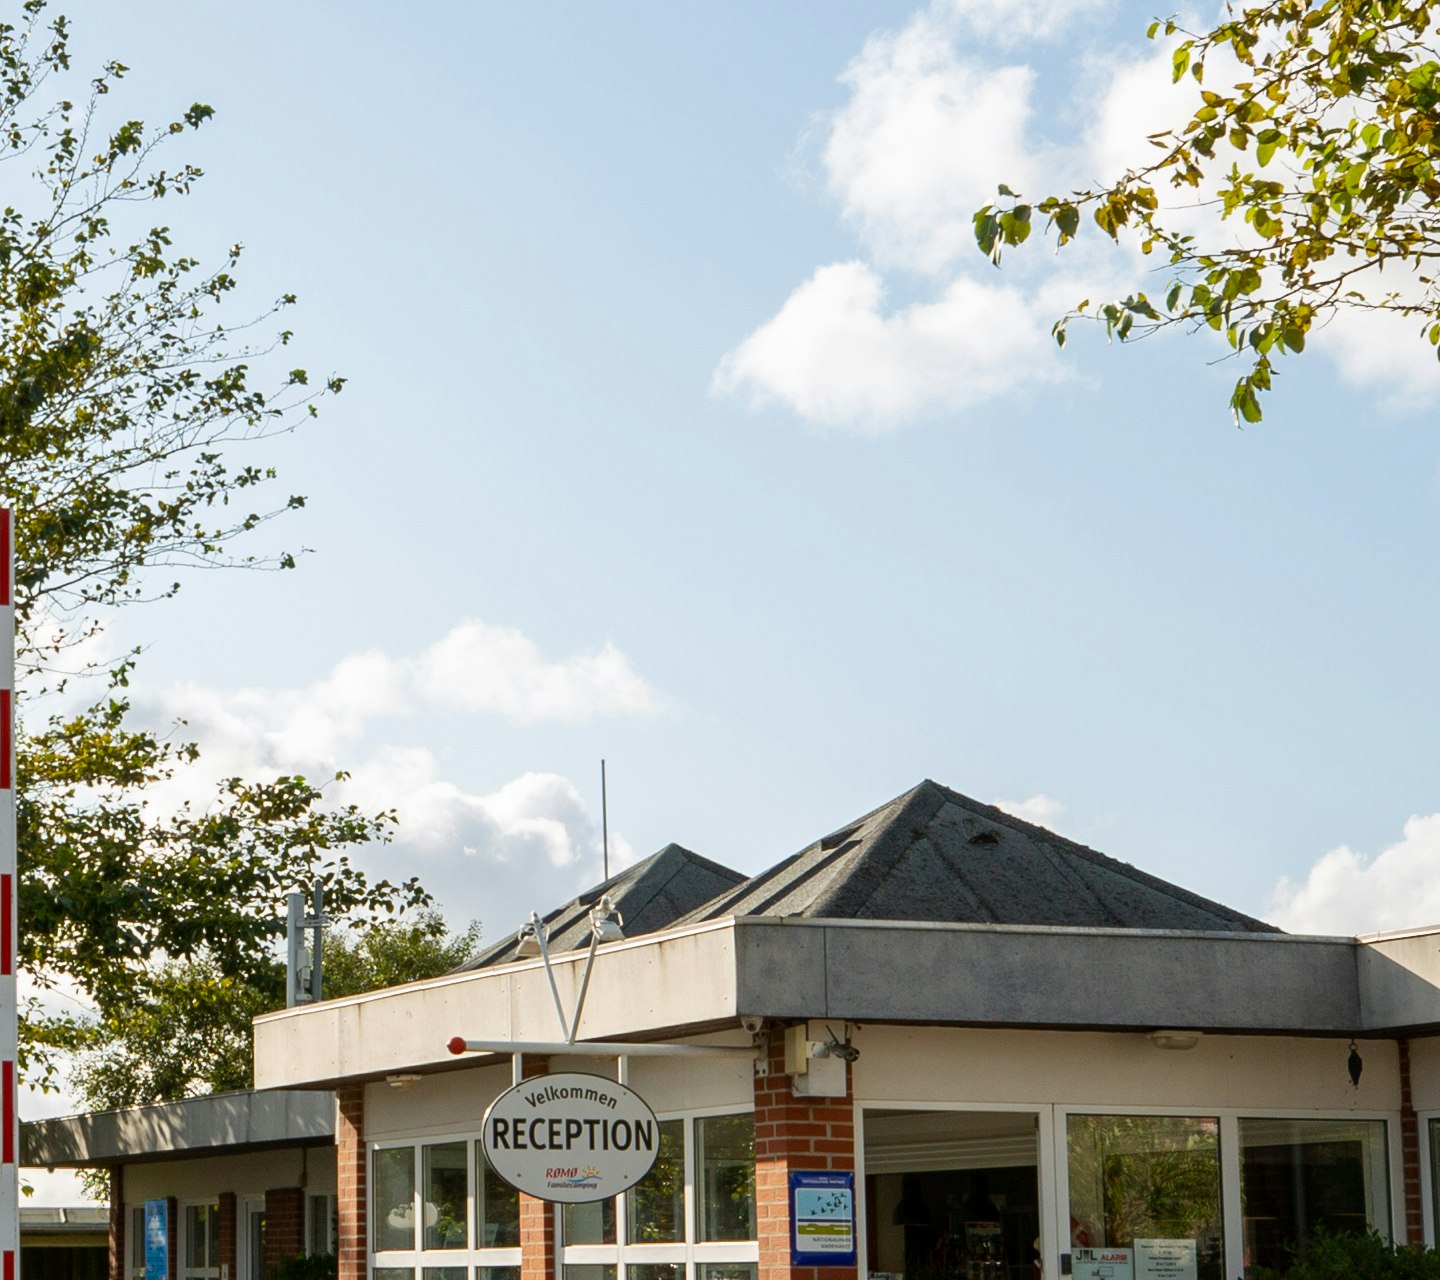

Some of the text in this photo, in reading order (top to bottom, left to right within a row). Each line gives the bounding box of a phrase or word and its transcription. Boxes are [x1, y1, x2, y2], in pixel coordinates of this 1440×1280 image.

[524, 1085, 618, 1110] Velkommen
[492, 1118, 653, 1151] RECEPTION
[545, 1167, 579, 1179] RØMØ
